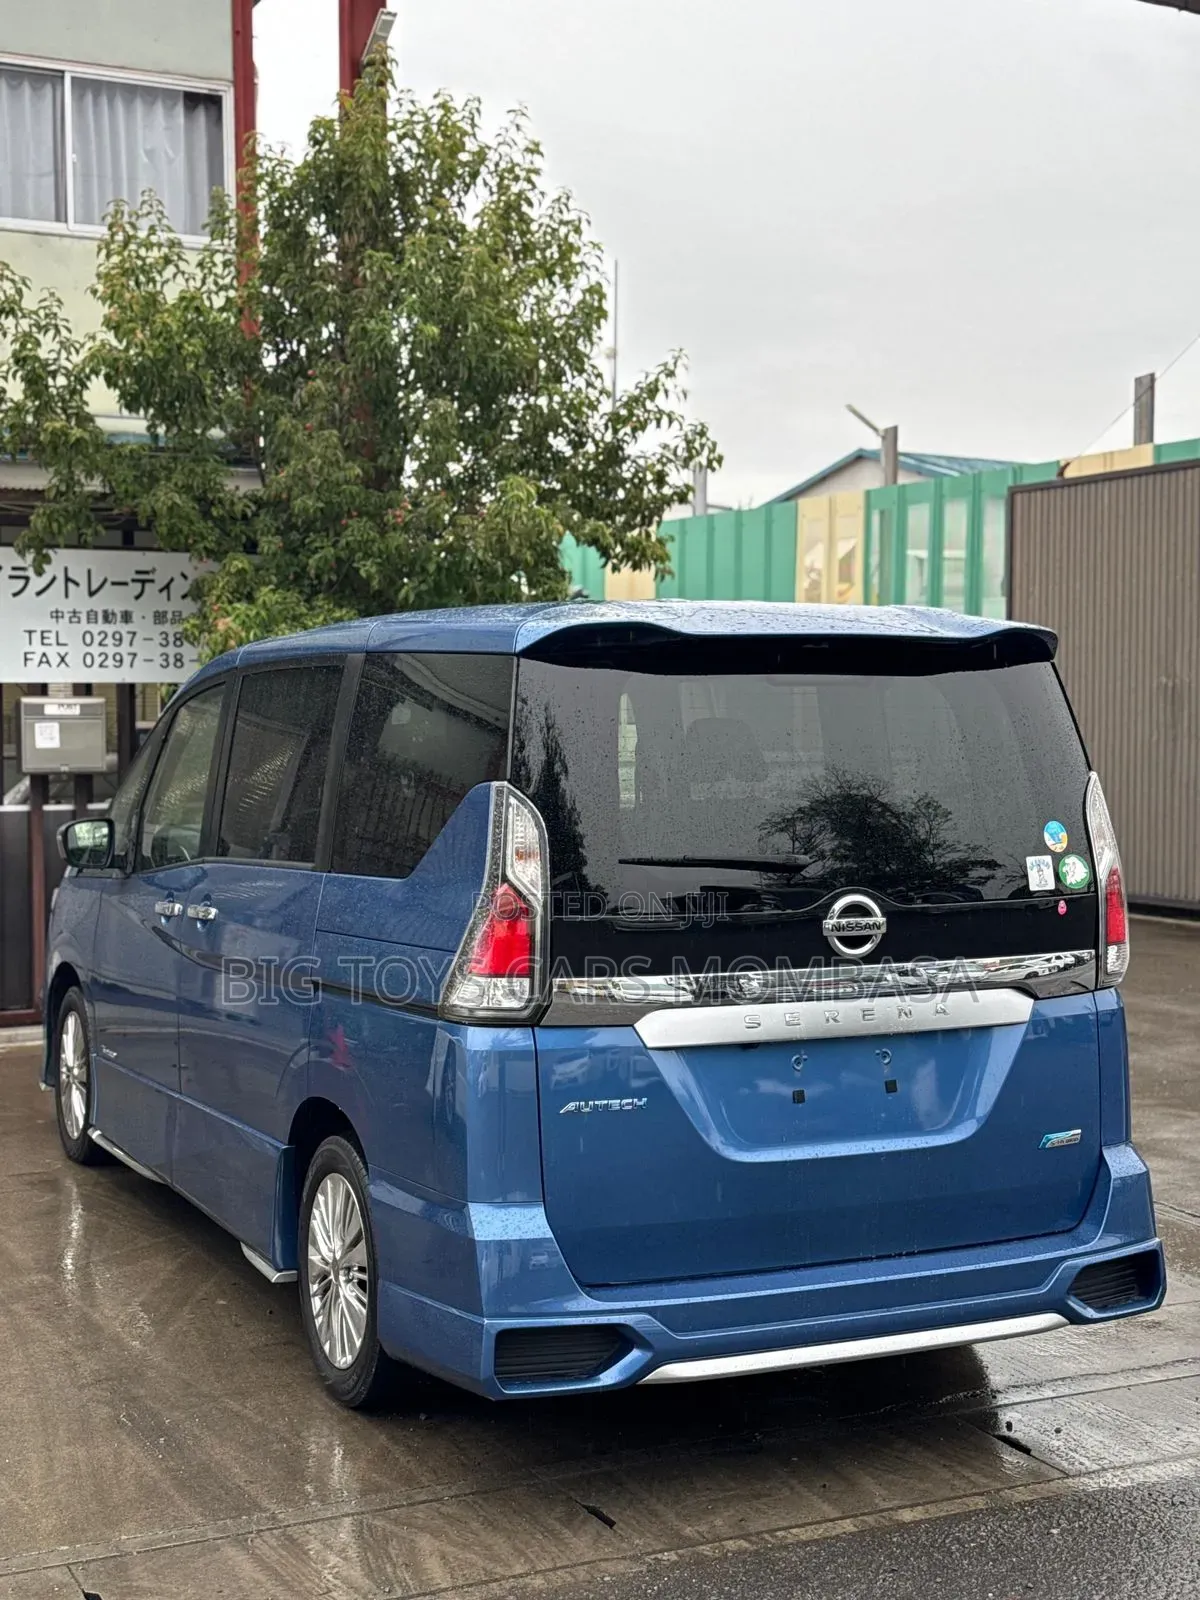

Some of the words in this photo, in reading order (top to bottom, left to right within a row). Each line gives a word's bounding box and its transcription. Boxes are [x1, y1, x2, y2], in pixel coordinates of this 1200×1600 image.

[0, 566, 194, 601] ラントレーディン
[50, 609, 183, 625] 中古自動車・部品
[24, 630, 69, 646] TEL
[23, 652, 70, 668] FAX
[831, 922, 881, 932] NISSAN
[743, 1002, 951, 1030] SERENA
[560, 1097, 648, 1114] AUTECH
